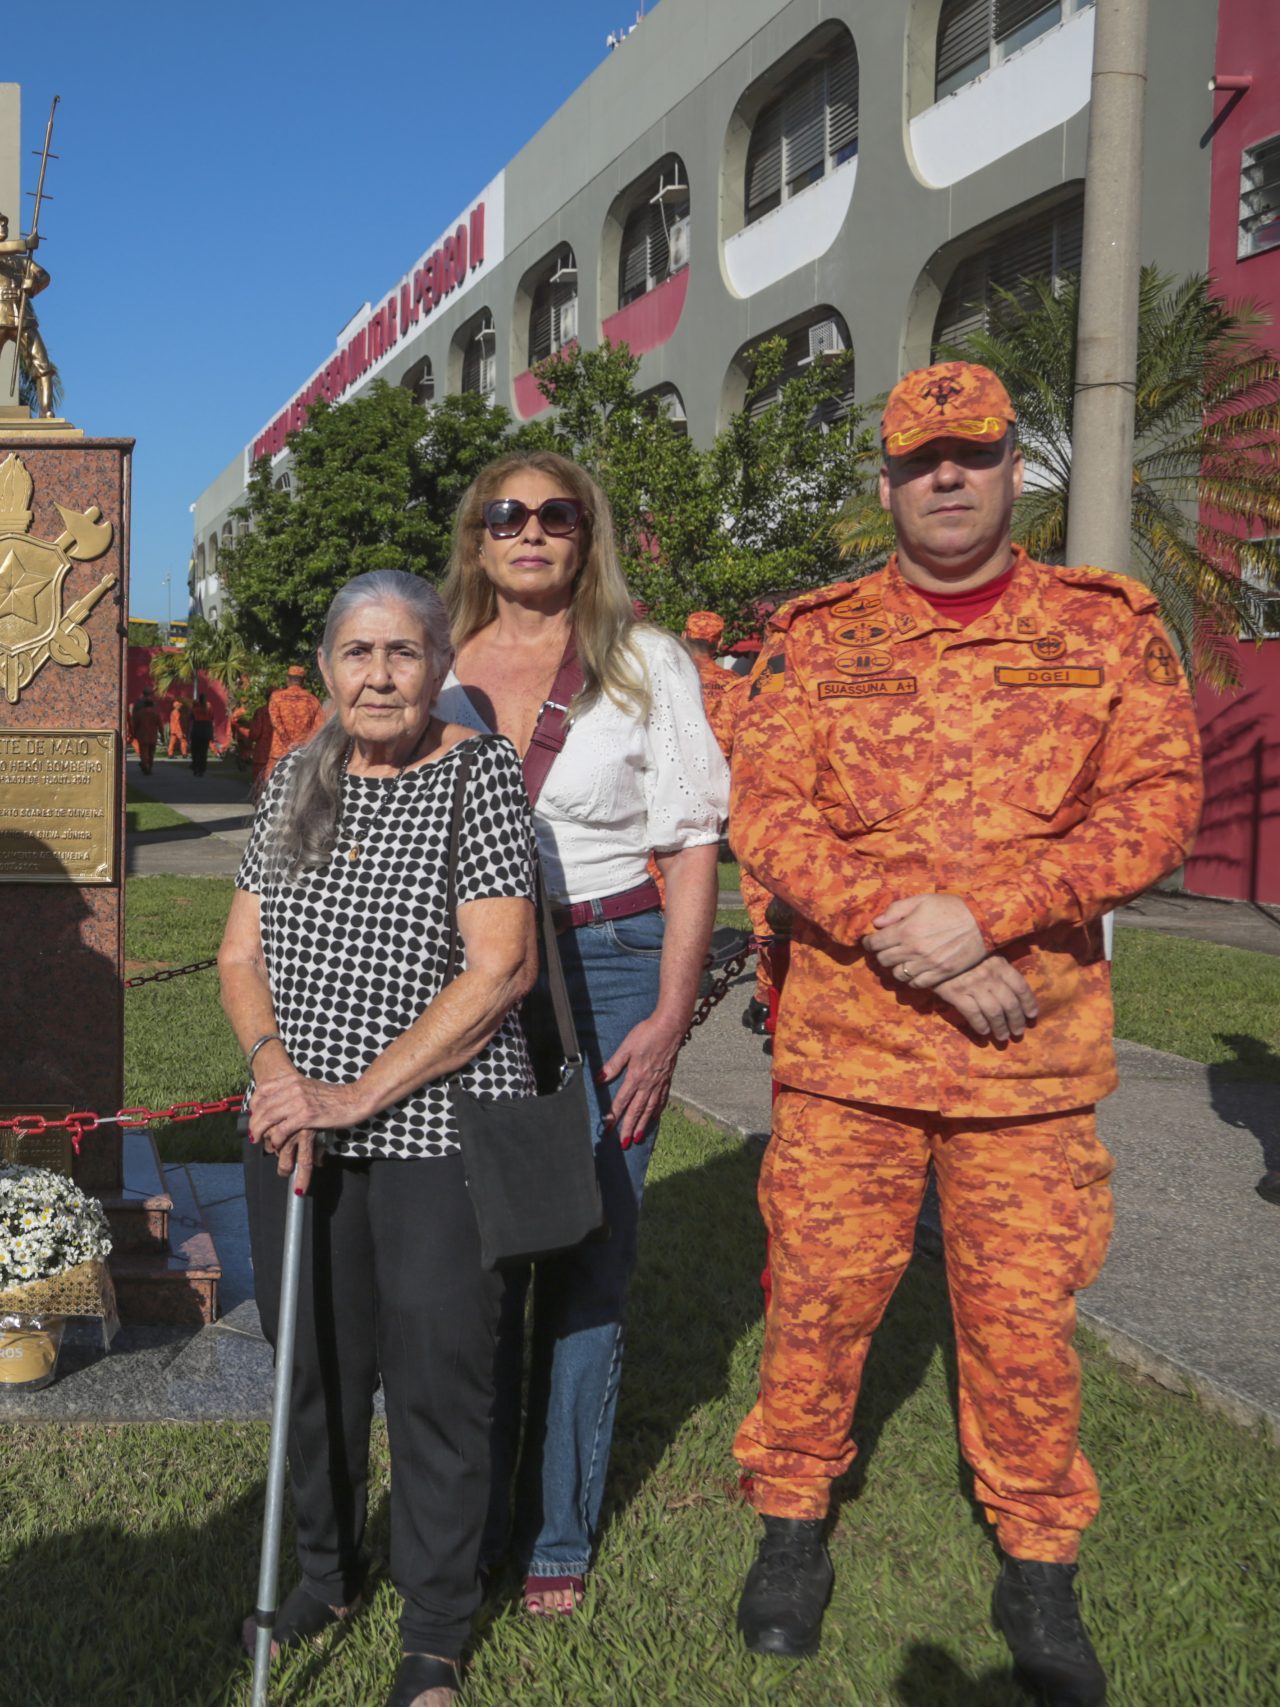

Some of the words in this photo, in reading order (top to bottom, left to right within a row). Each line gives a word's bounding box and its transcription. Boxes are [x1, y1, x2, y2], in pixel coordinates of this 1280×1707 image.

[470, 202, 485, 273] II
[1028, 671, 1070, 681] DGEI
[824, 683, 888, 694] SUASSUNA
[896, 682, 913, 691] A+
[26, 739, 45, 756] DE
[50, 739, 89, 756] MAIO
[10, 758, 44, 773] HERÓI
[46, 760, 103, 774] BOMBEIRO
[20, 808, 52, 818] SOARES
[54, 808, 67, 818] DE
[68, 808, 105, 818] OLIVEIRA
[36, 830, 60, 840] SILVA
